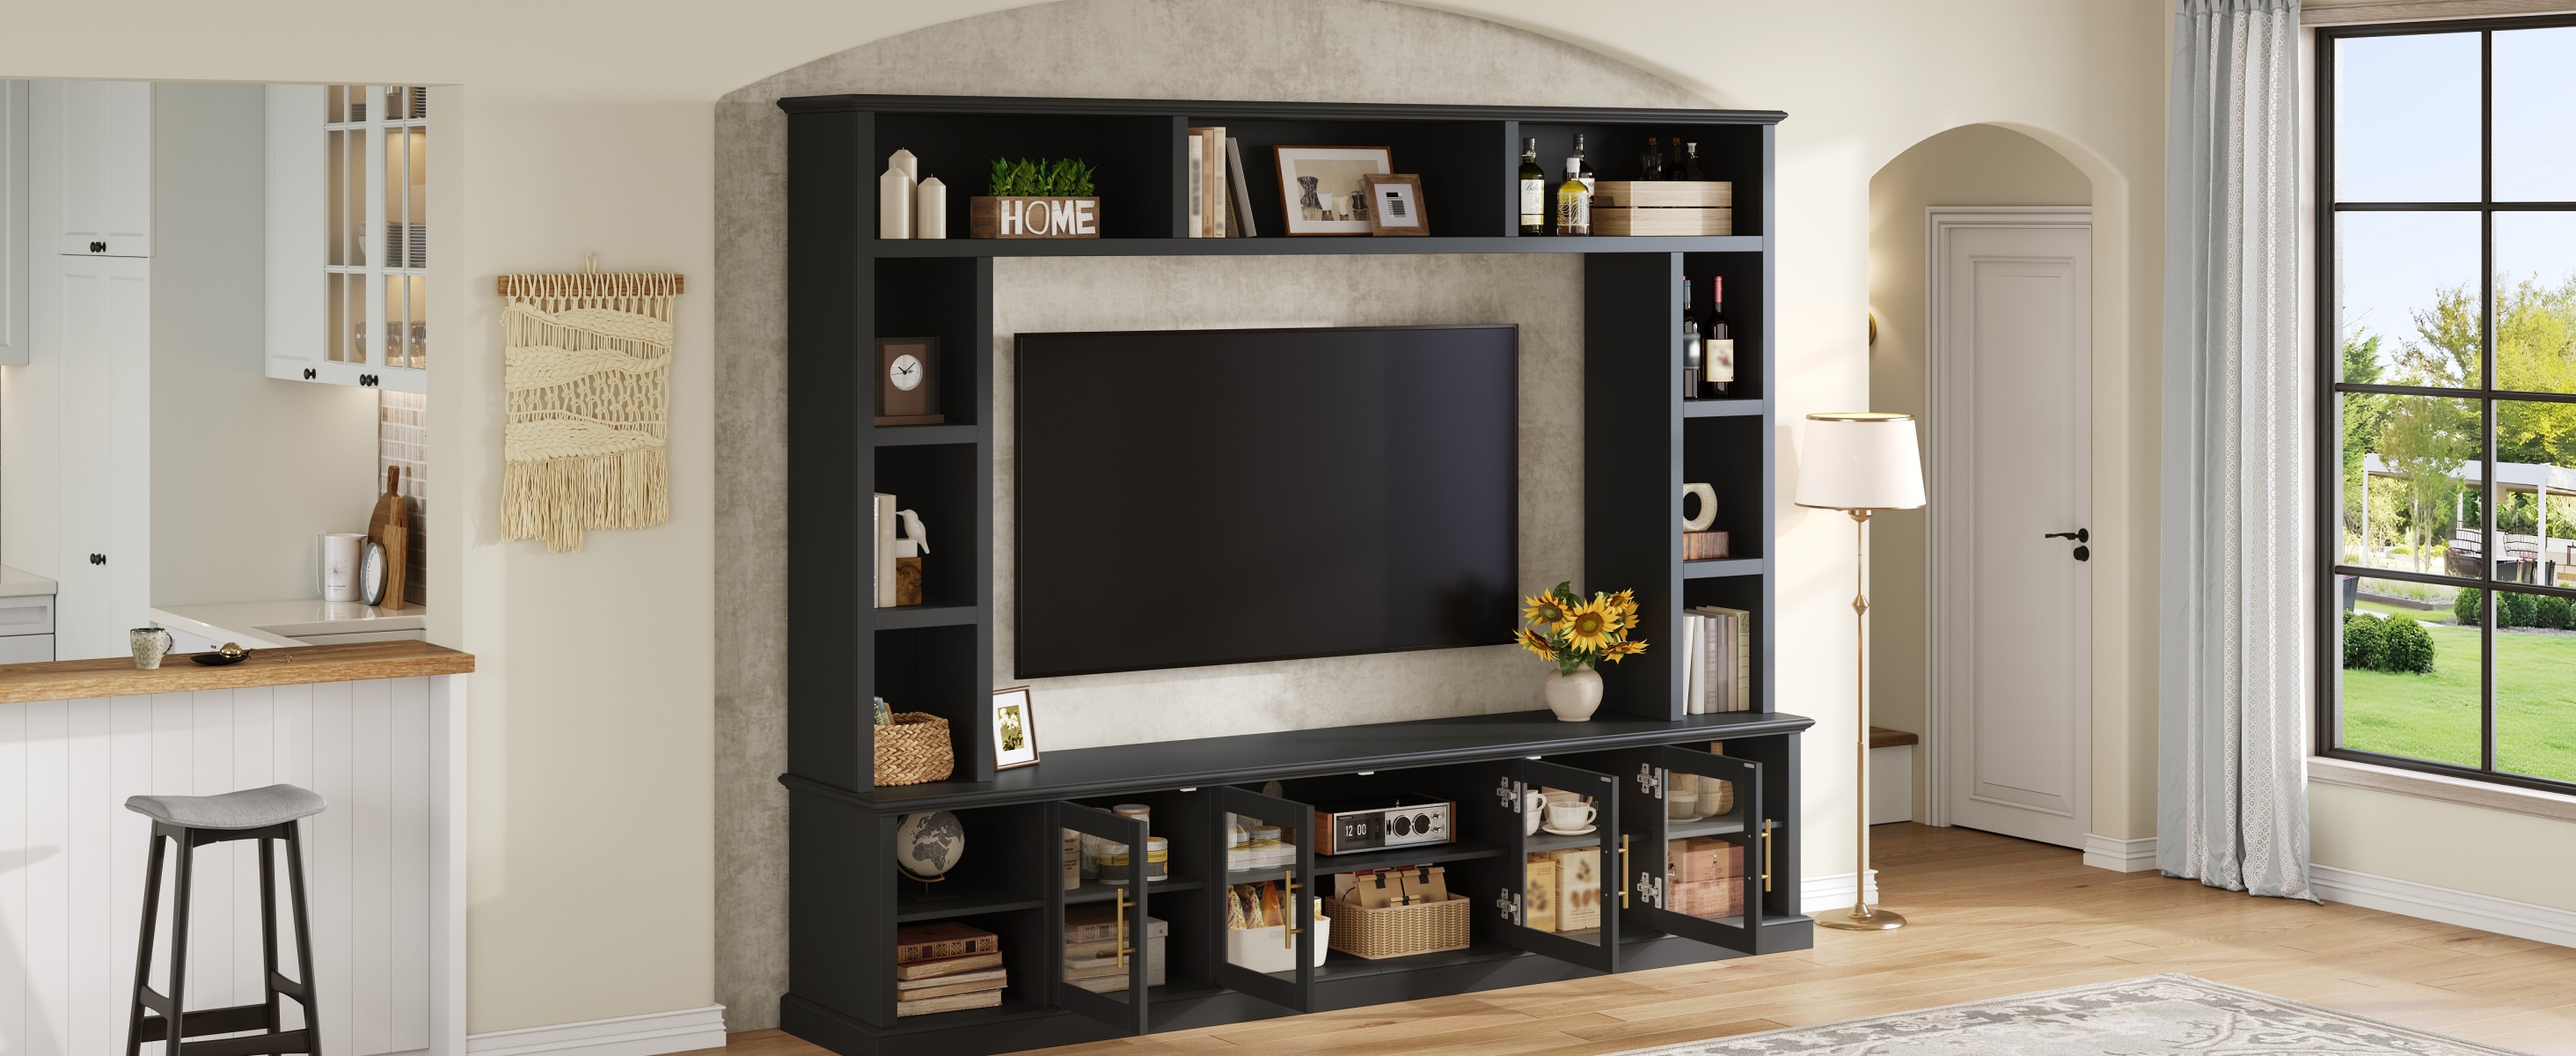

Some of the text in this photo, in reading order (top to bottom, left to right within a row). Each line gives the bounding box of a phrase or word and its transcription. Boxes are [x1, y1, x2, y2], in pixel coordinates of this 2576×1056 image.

[1001, 200, 1096, 236] HOME
[1345, 824, 1366, 837] 12 00
